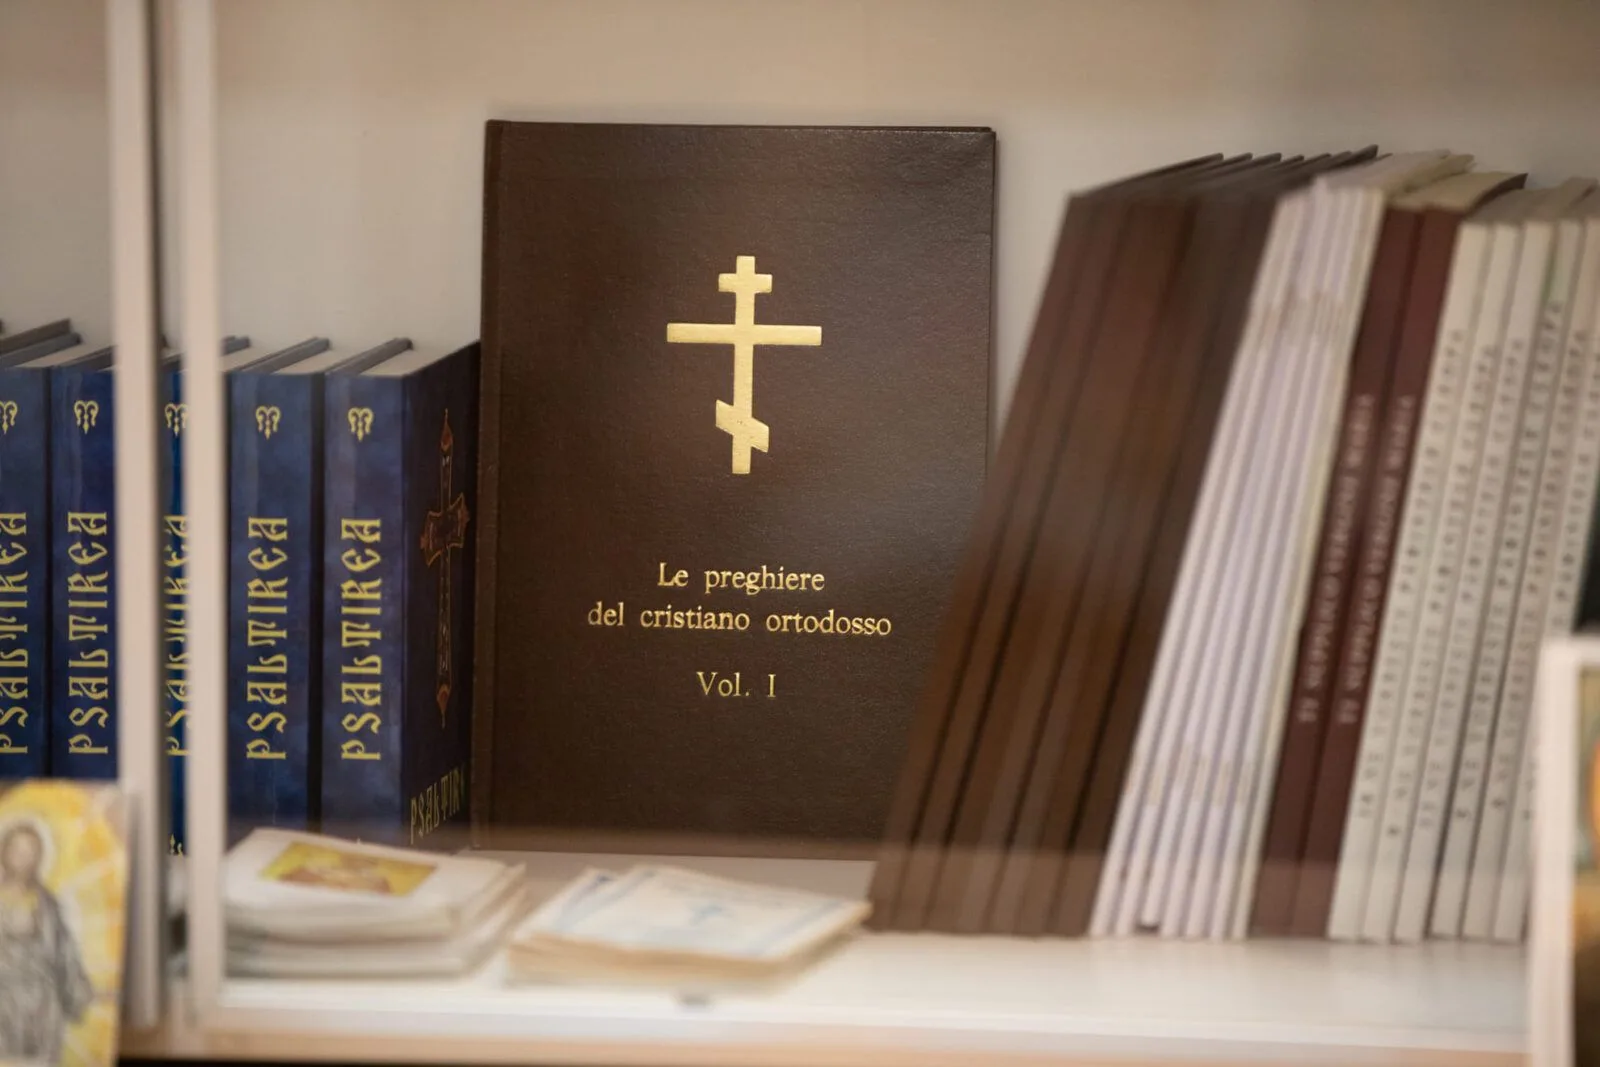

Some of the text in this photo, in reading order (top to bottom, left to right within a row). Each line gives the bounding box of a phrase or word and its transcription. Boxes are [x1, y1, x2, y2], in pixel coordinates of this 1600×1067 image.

[587, 601, 892, 636] del cristiano ortodosso
[657, 562, 825, 595] Le preghiere
[68, 511, 108, 754] PSALTIREA
[247, 517, 288, 760] PSALTIREA
[340, 518, 382, 761] PSALTIREA
[696, 671, 777, 698] Vol. I
[411, 765, 465, 845] PSALTIR
